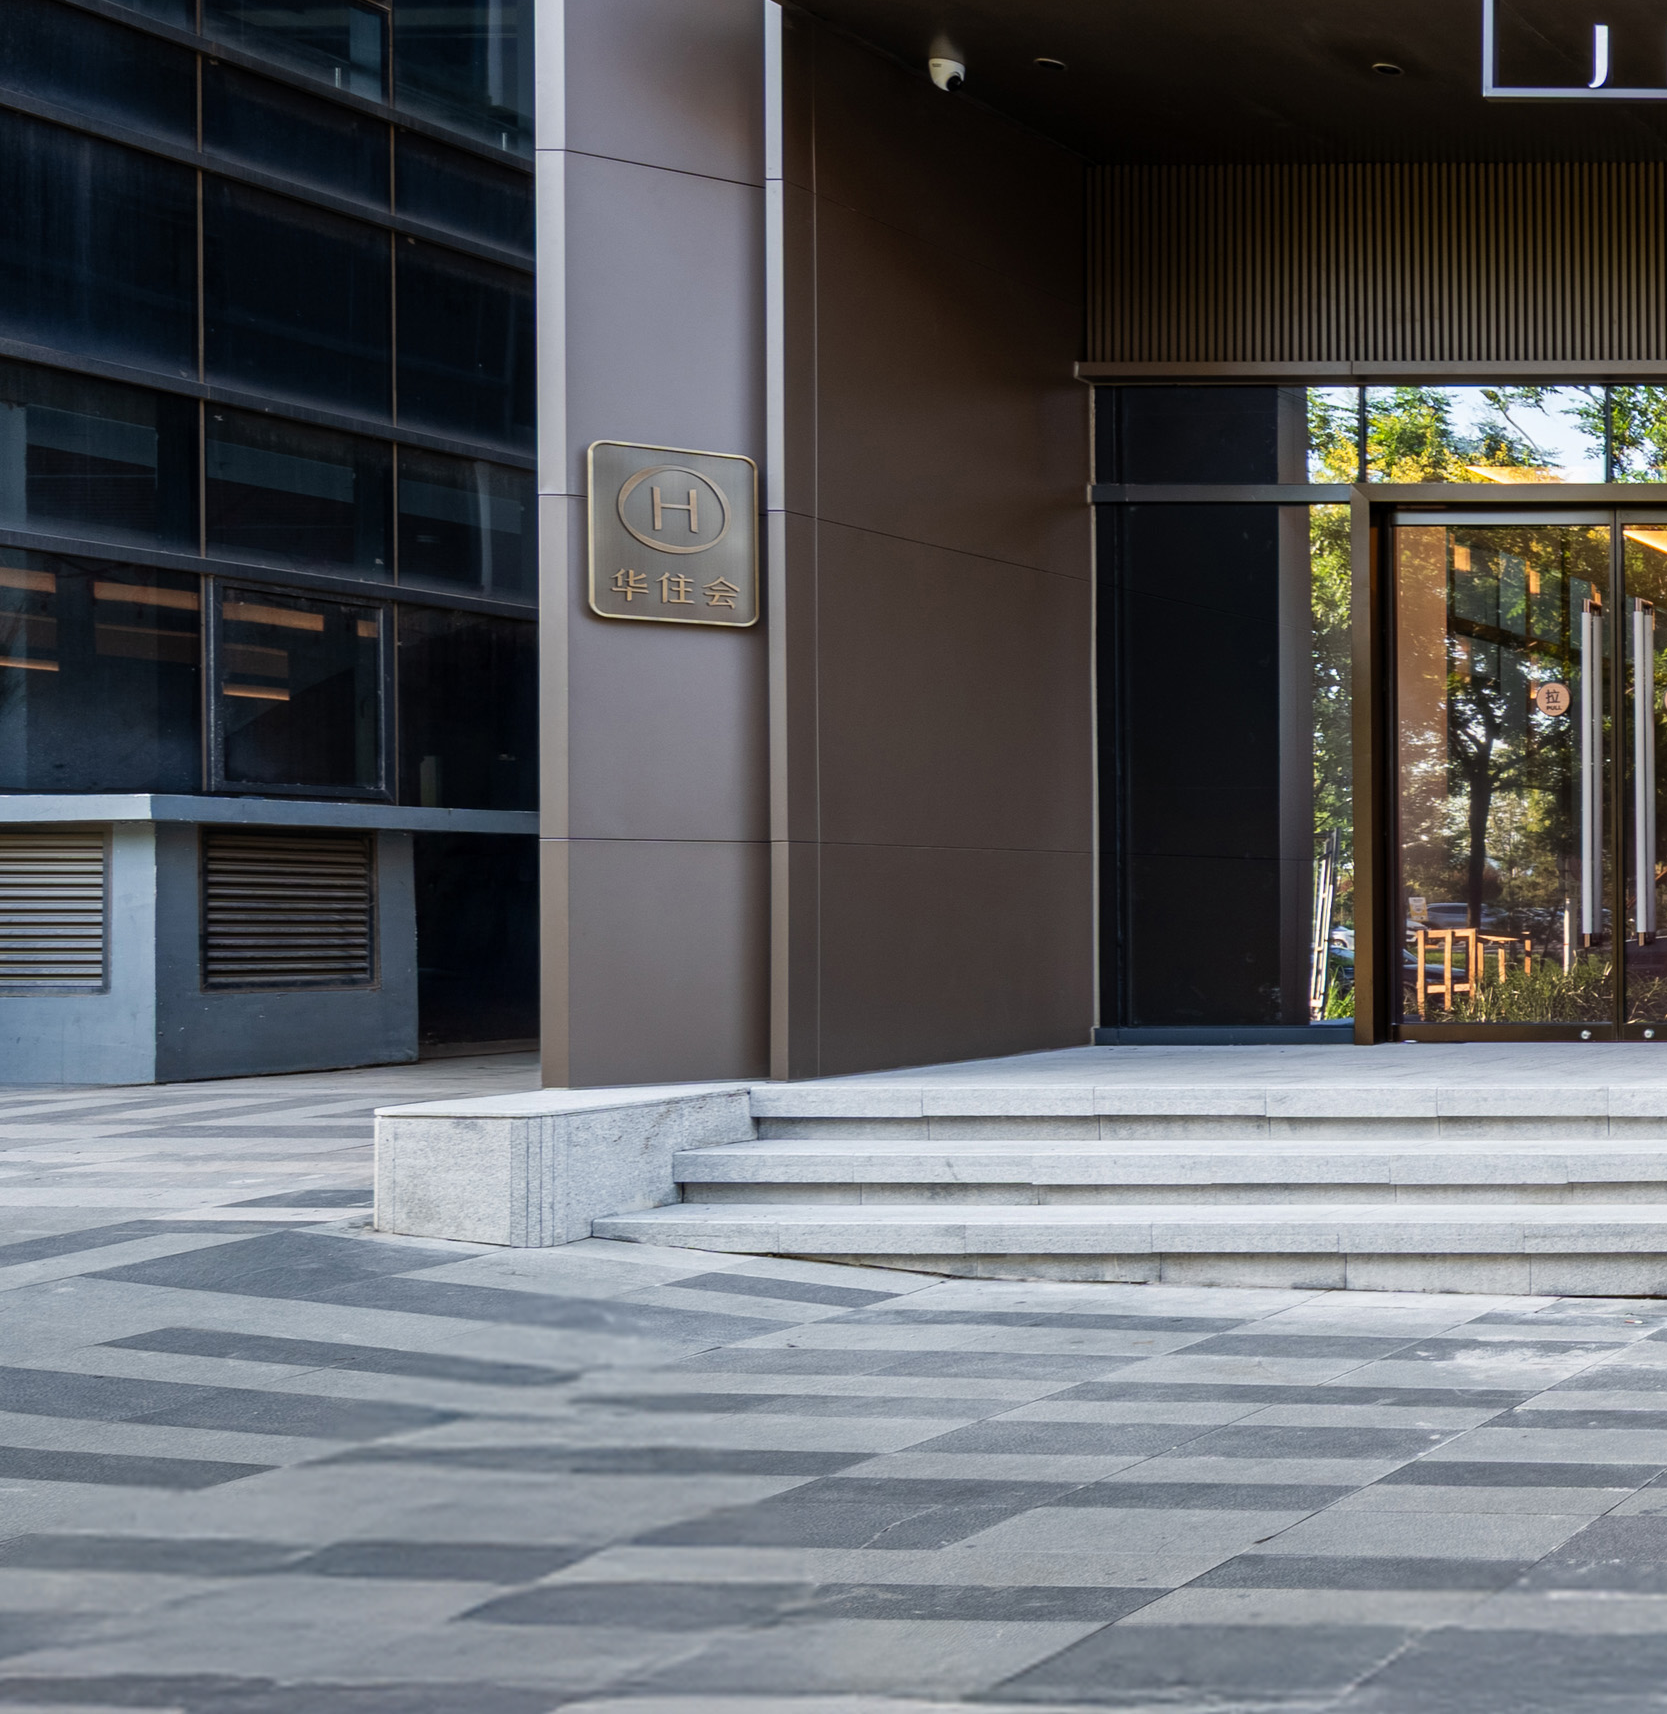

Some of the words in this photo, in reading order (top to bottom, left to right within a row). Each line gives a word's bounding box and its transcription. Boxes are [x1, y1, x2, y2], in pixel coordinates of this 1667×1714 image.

[610, 567, 742, 611] 华住会
[1545, 689, 1561, 705] 拉
